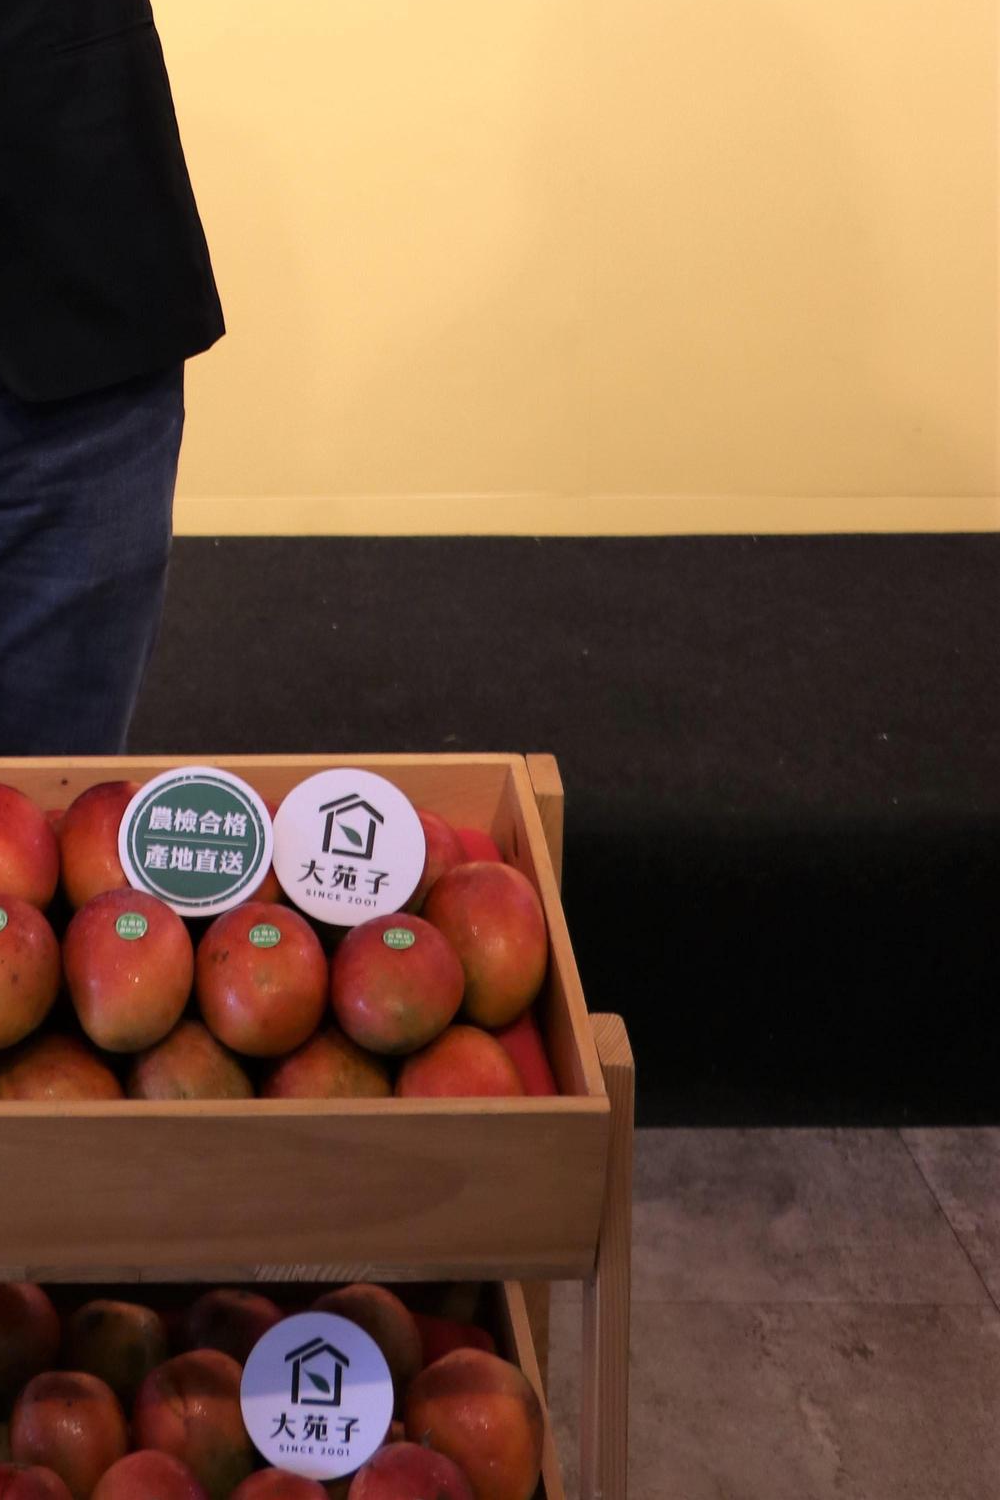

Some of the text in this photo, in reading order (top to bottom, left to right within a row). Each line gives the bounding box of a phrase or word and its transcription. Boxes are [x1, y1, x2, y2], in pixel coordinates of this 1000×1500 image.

[148, 805, 248, 838] 農檢合格
[144, 844, 244, 876] 產地直送
[297, 859, 390, 895] 大苑子
[305, 888, 378, 908] SINCE 2001
[270, 1413, 360, 1444] 大苑子
[279, 1444, 350, 1457] SINCE 2001
